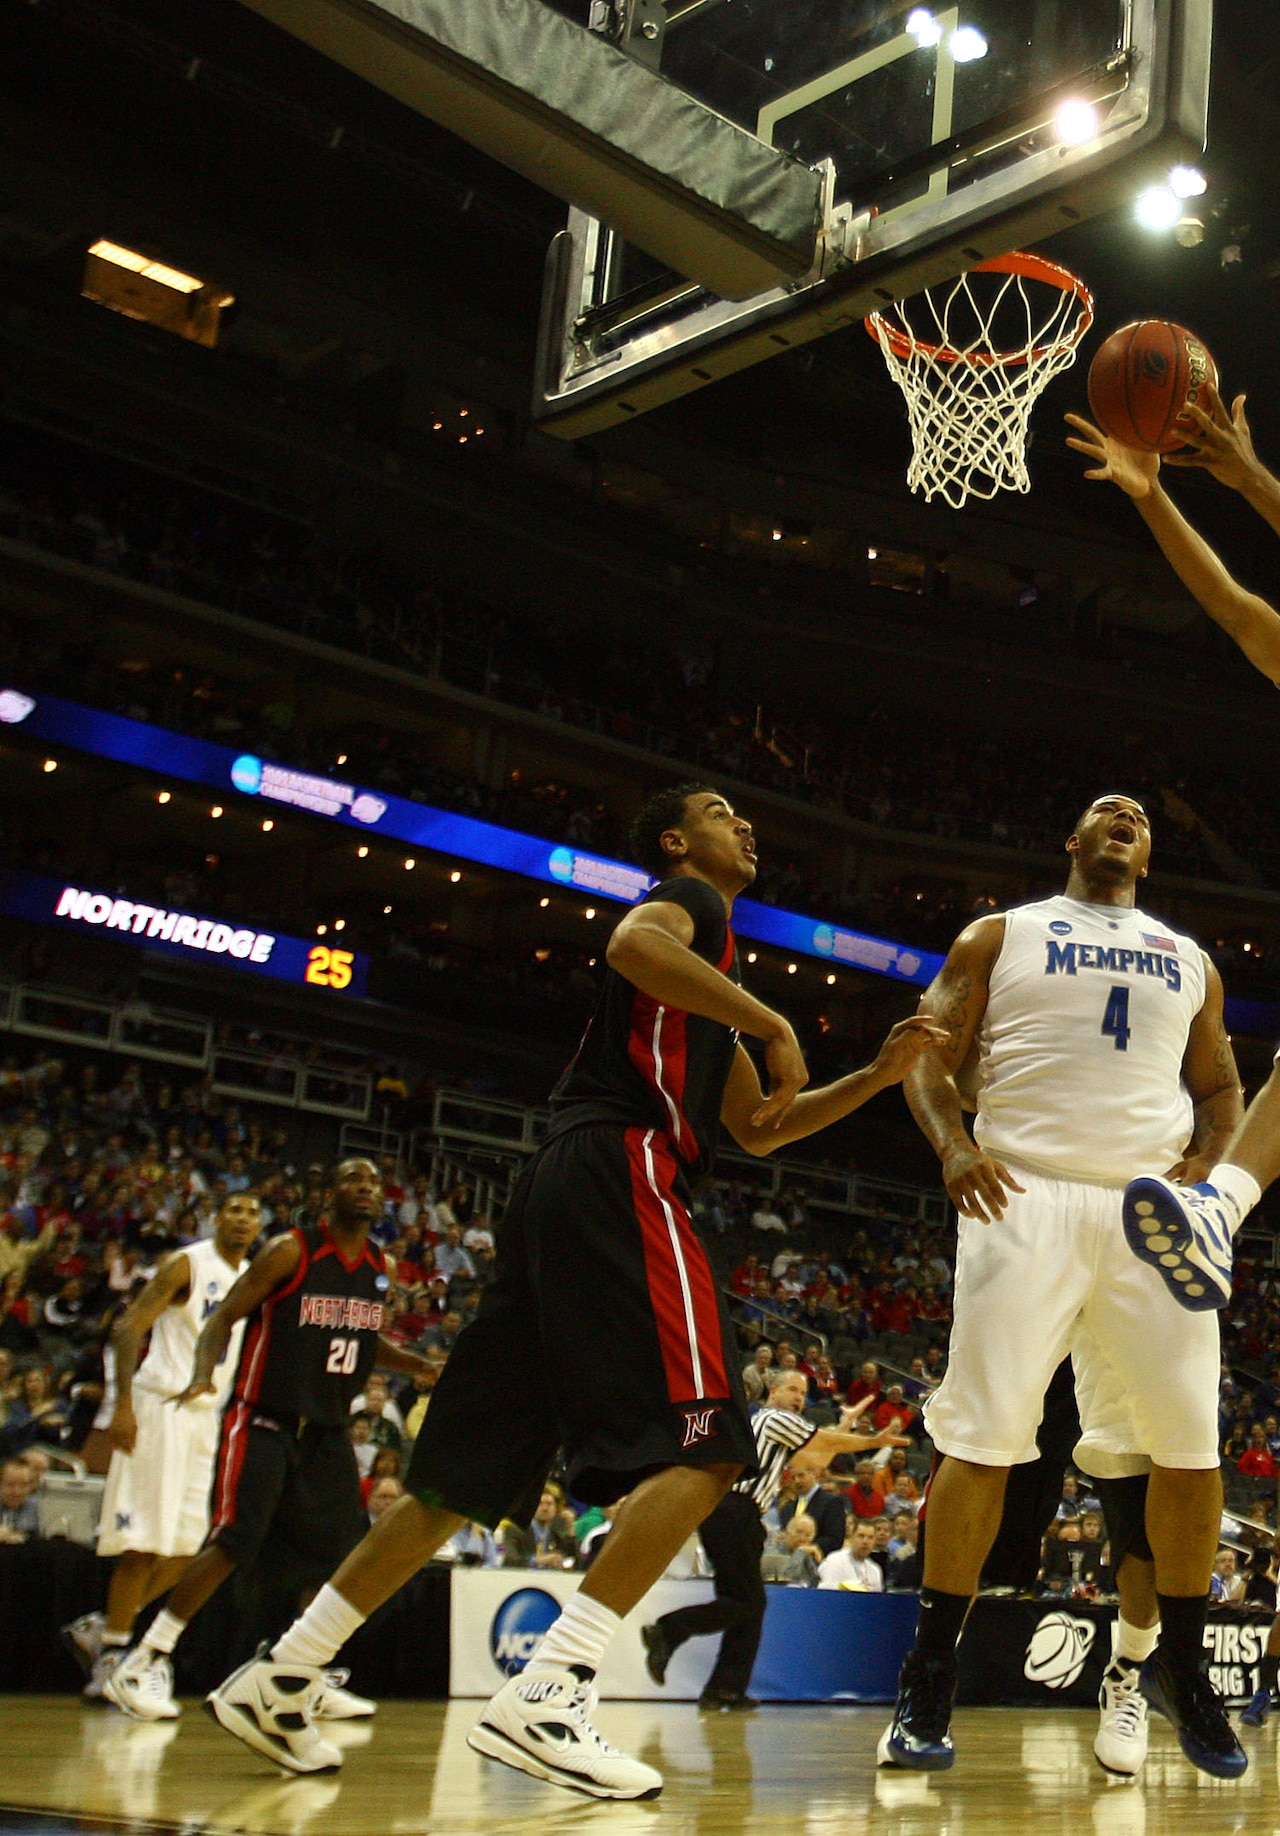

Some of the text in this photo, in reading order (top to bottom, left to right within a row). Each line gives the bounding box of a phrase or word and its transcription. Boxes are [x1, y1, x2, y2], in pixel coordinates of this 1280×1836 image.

[55, 886, 276, 963] NORTHRIDGE
[305, 945, 355, 990] 25
[1045, 940, 1182, 992] MEMPHIS
[1101, 985, 1131, 1052] 4
[326, 1338, 360, 1374] 20
[1202, 1623, 1272, 1665] FIRST
[1208, 1665, 1246, 1696] BIG
